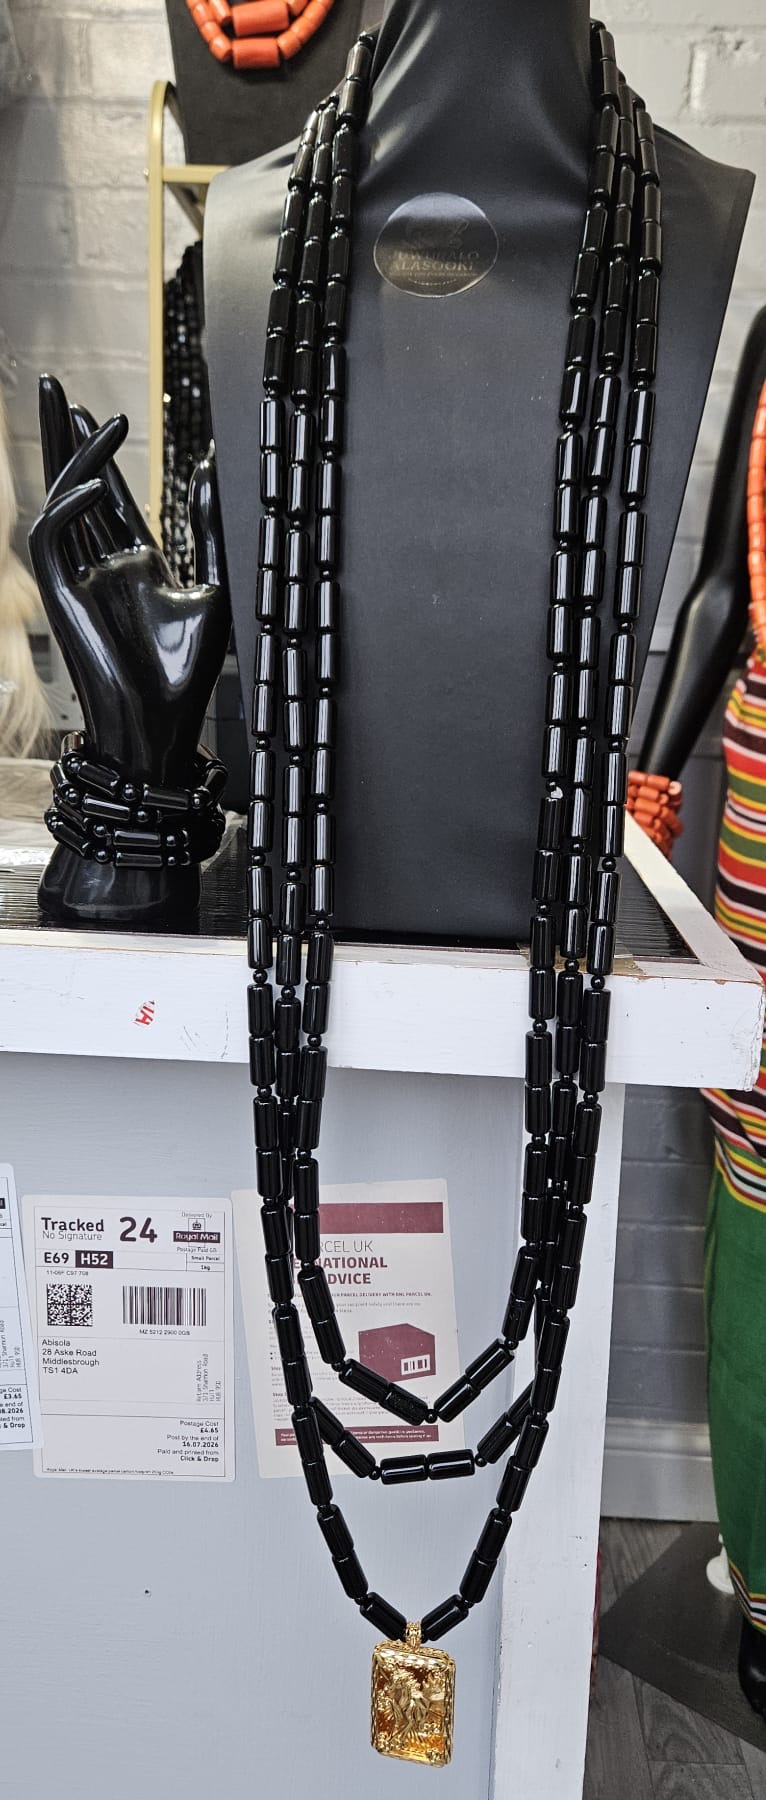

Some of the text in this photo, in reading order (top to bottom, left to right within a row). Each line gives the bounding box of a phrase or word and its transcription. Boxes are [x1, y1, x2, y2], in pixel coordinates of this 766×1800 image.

[41, 1216, 158, 1243] Tracked 24
[43, 1231, 102, 1241] No Signature
[176, 1233, 198, 1241] Royal
[354, 1240, 373, 1252] UK
[44, 1252, 108, 1265] E69 H52
[328, 1273, 371, 1285] DVICE
[42, 1348, 52, 1356] 28
[55, 1348, 73, 1356] Aske
[42, 1358, 99, 1367] Middlesbrough
[180, 1420, 203, 1428] Postage
